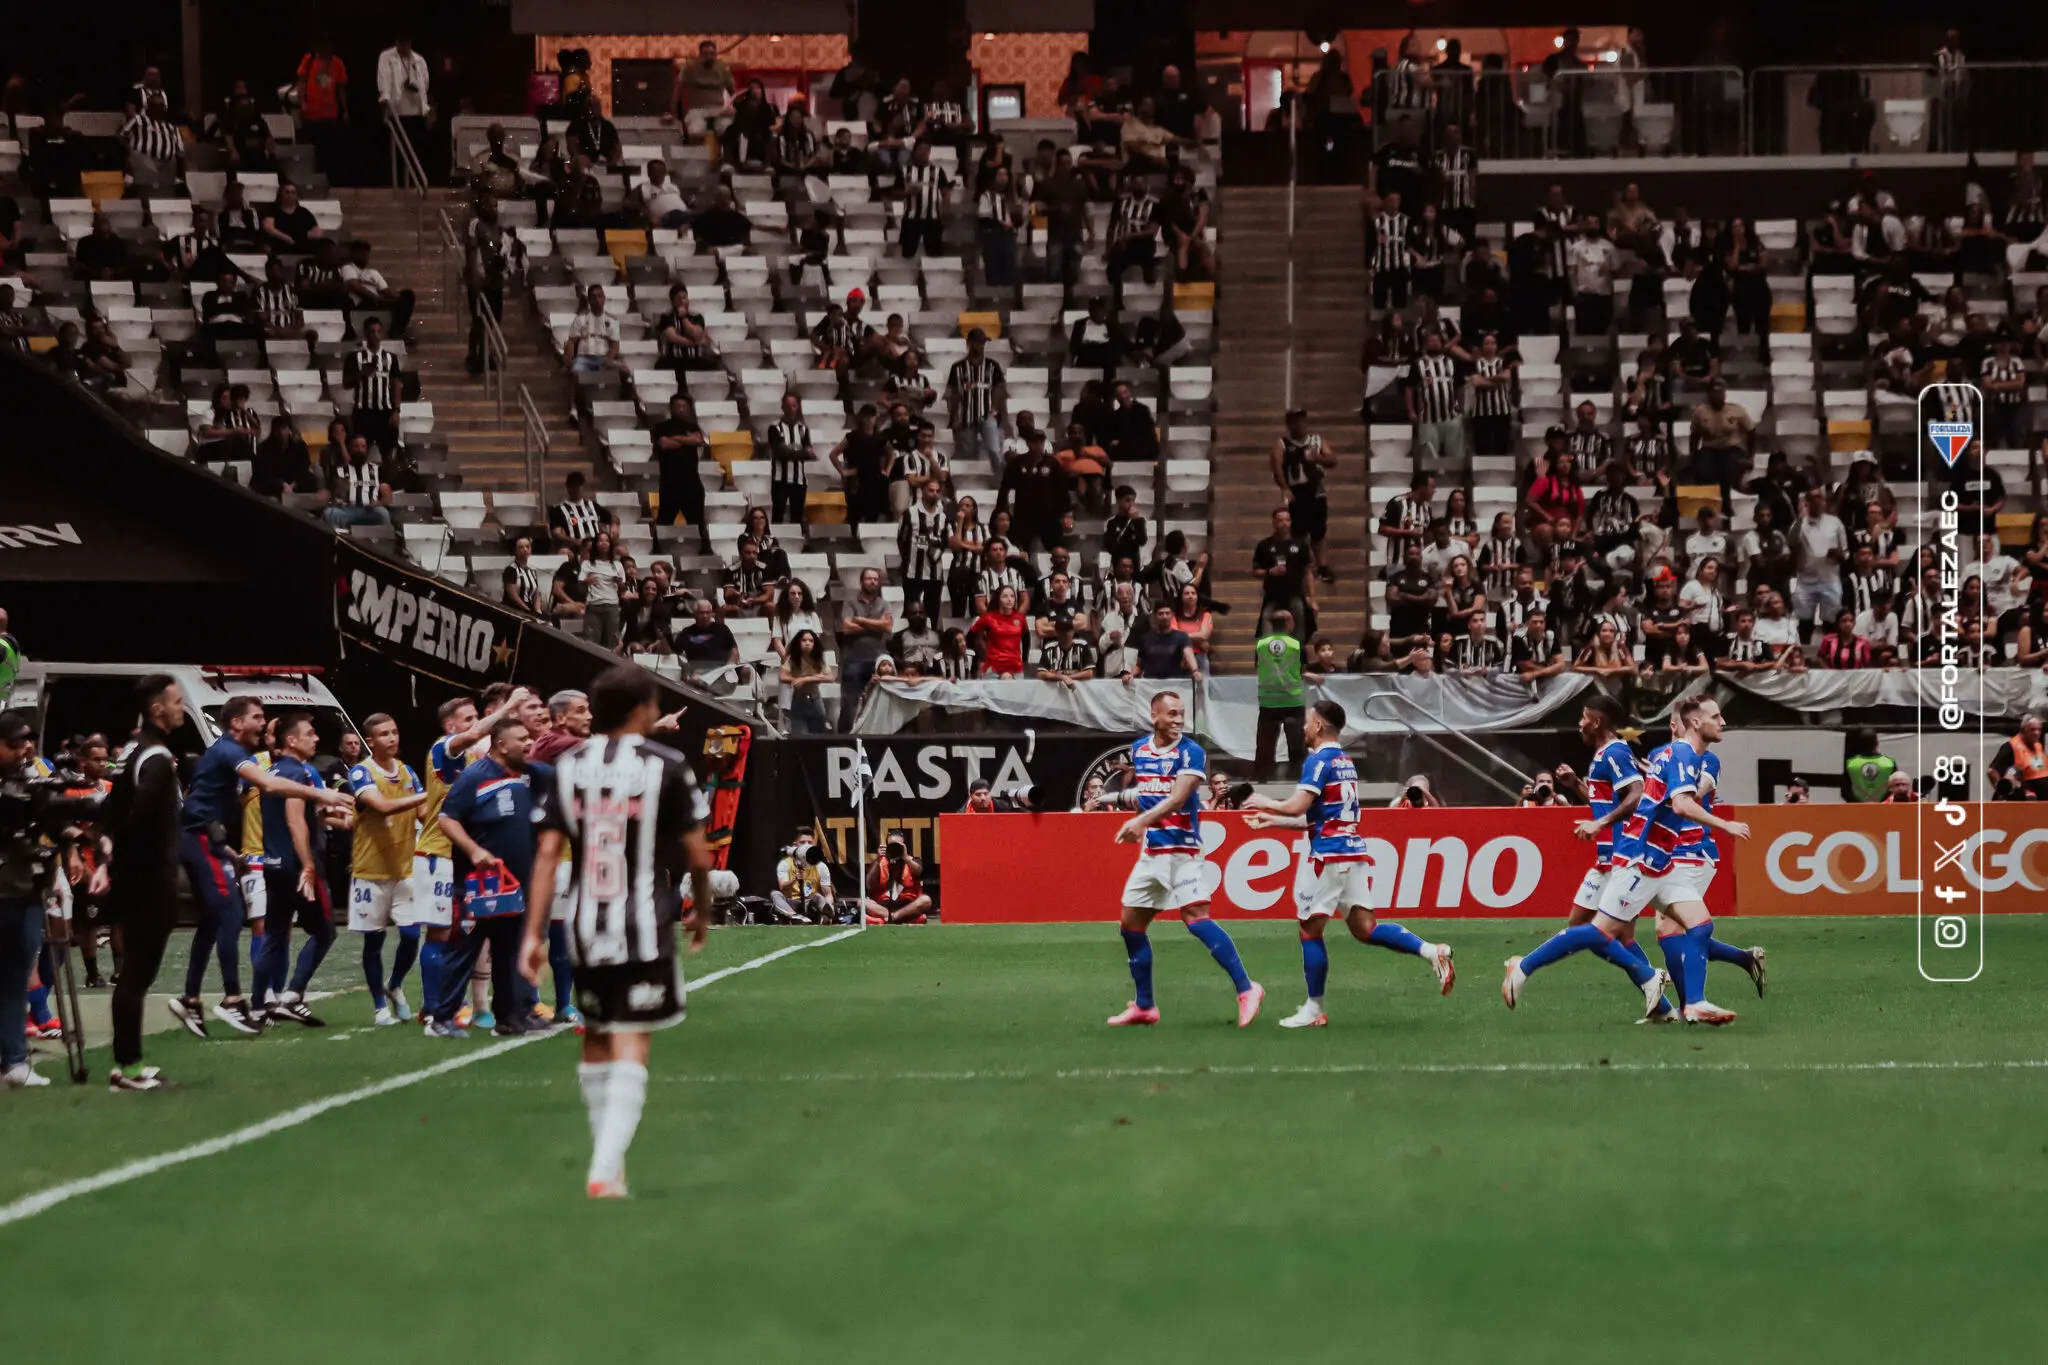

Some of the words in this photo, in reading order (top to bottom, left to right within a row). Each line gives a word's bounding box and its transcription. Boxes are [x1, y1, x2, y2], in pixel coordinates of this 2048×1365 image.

[0, 523, 83, 549] RV
[347, 568, 495, 674] IMPÉRIO
[1765, 830, 1923, 895] GOL
[354, 887, 372, 904] 34
[434, 880, 453, 898] 88
